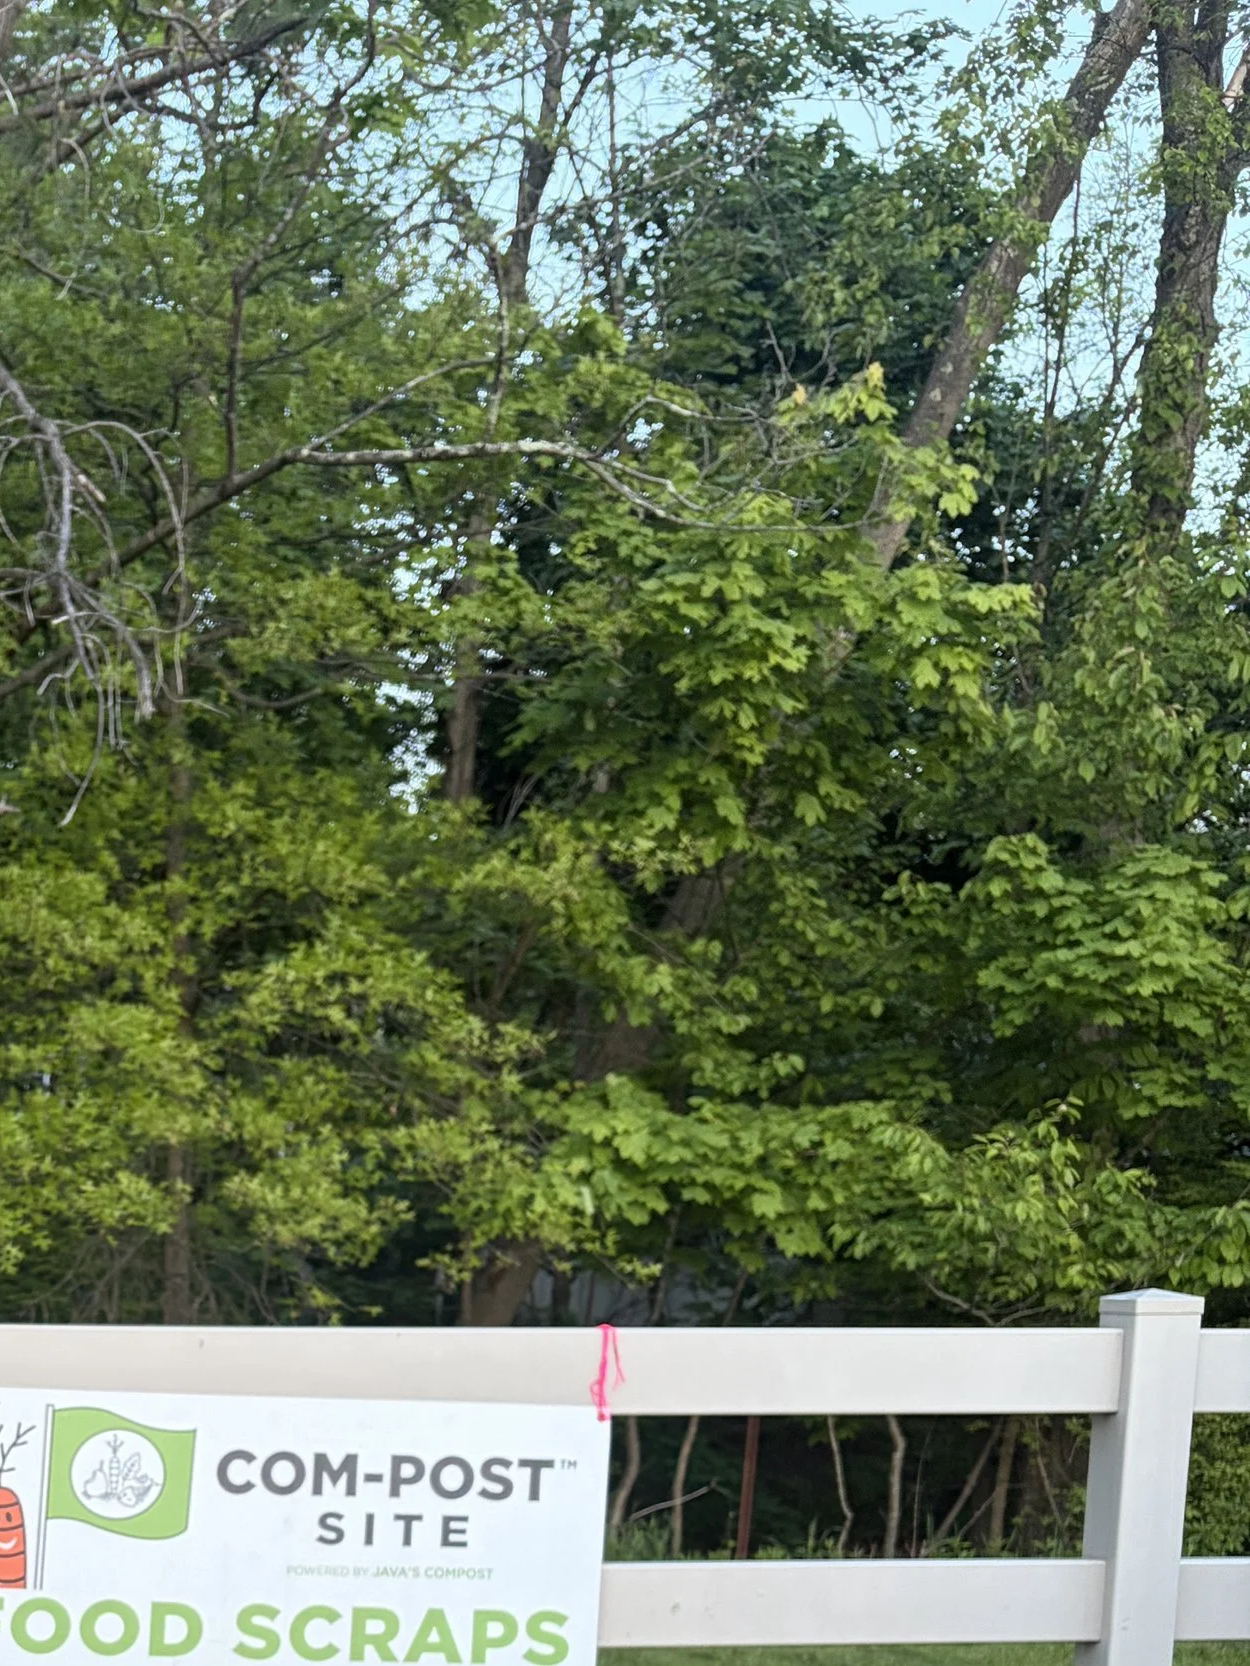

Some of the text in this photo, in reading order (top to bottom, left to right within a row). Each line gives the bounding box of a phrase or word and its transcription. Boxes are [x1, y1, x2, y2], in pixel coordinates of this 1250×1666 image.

[217, 1450, 555, 1501] COM-POST
[316, 1512, 469, 1547] SITE
[286, 1565, 493, 1580] POWERED BY JAVA'S COMPOST
[232, 1604, 569, 1666] SCRAPS
